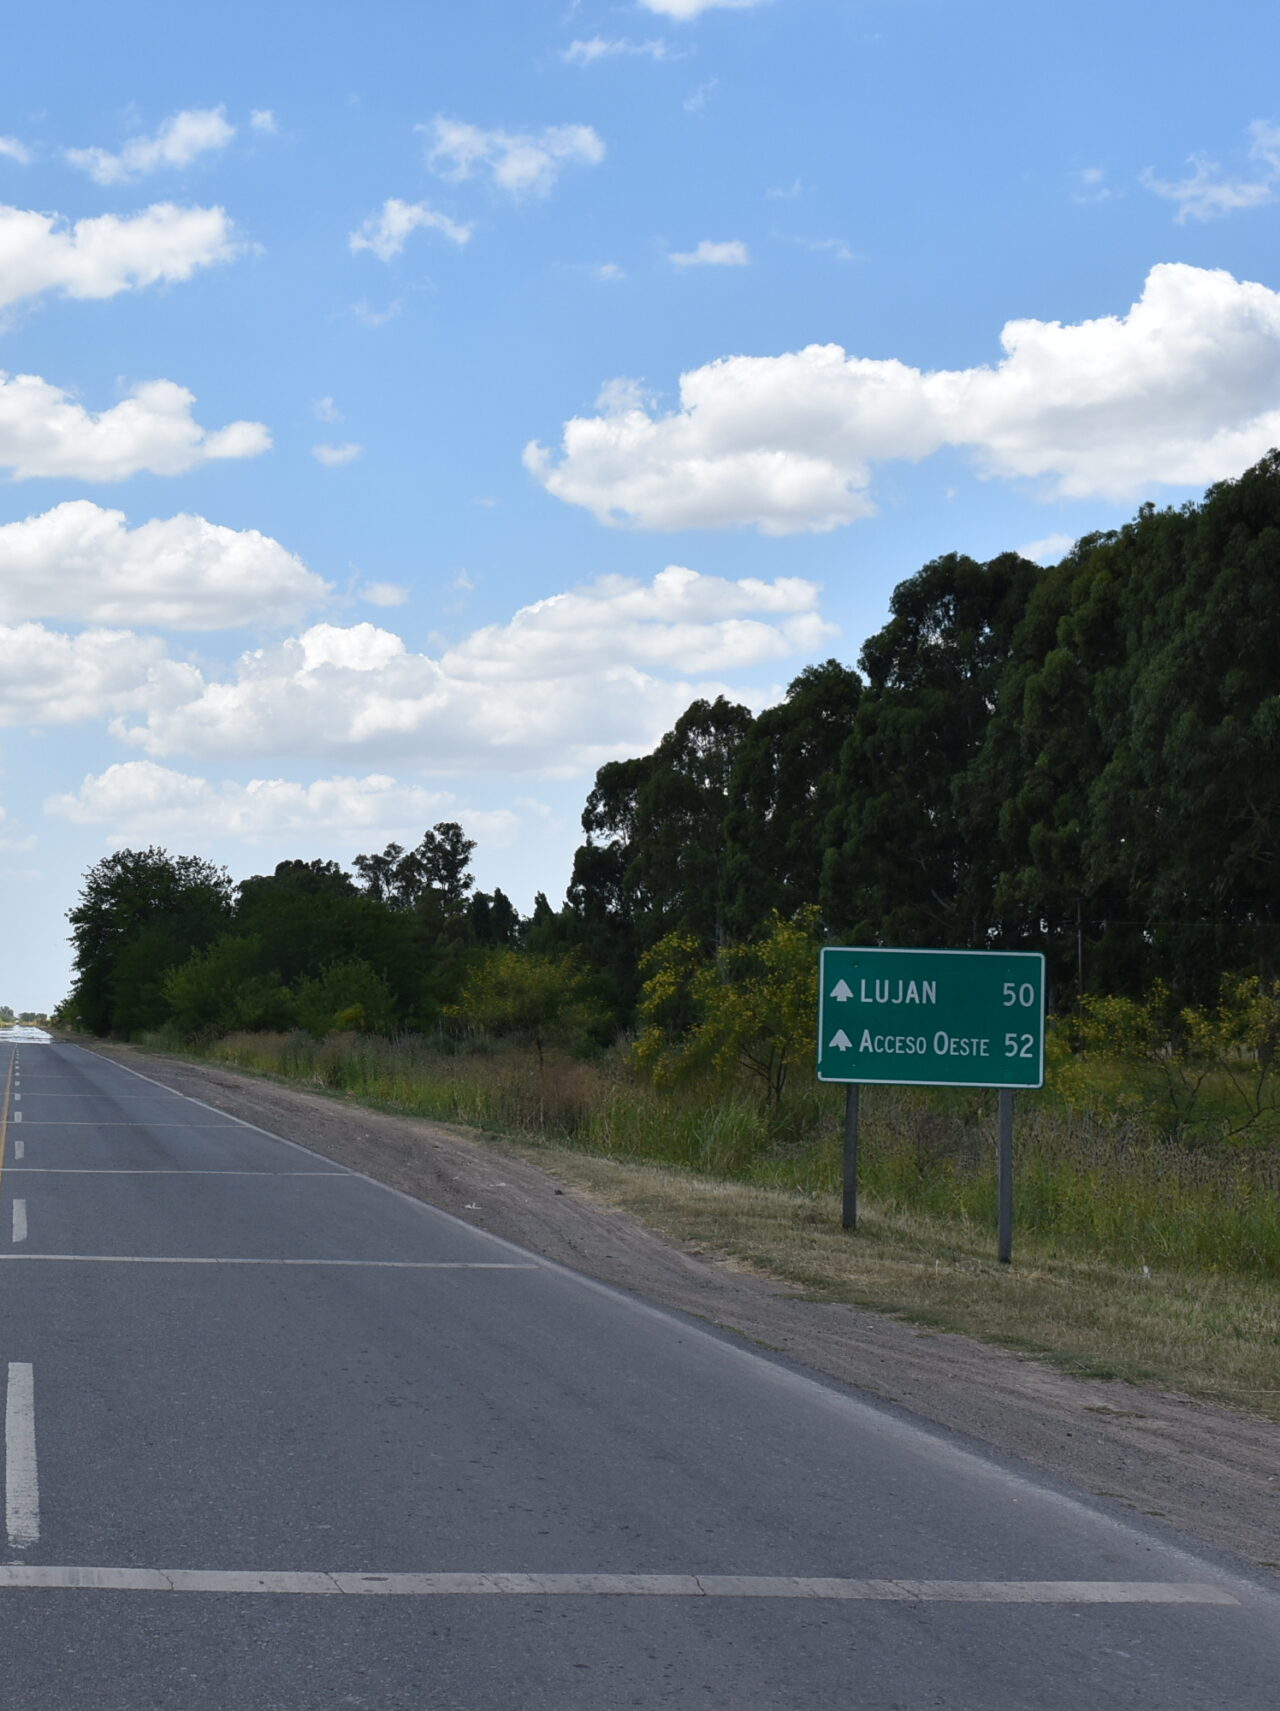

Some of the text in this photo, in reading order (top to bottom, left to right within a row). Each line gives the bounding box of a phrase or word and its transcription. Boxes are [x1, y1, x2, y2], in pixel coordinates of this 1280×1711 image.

[860, 979, 1035, 1007] LUJAN 50
[1004, 1033, 1034, 1058] 52
